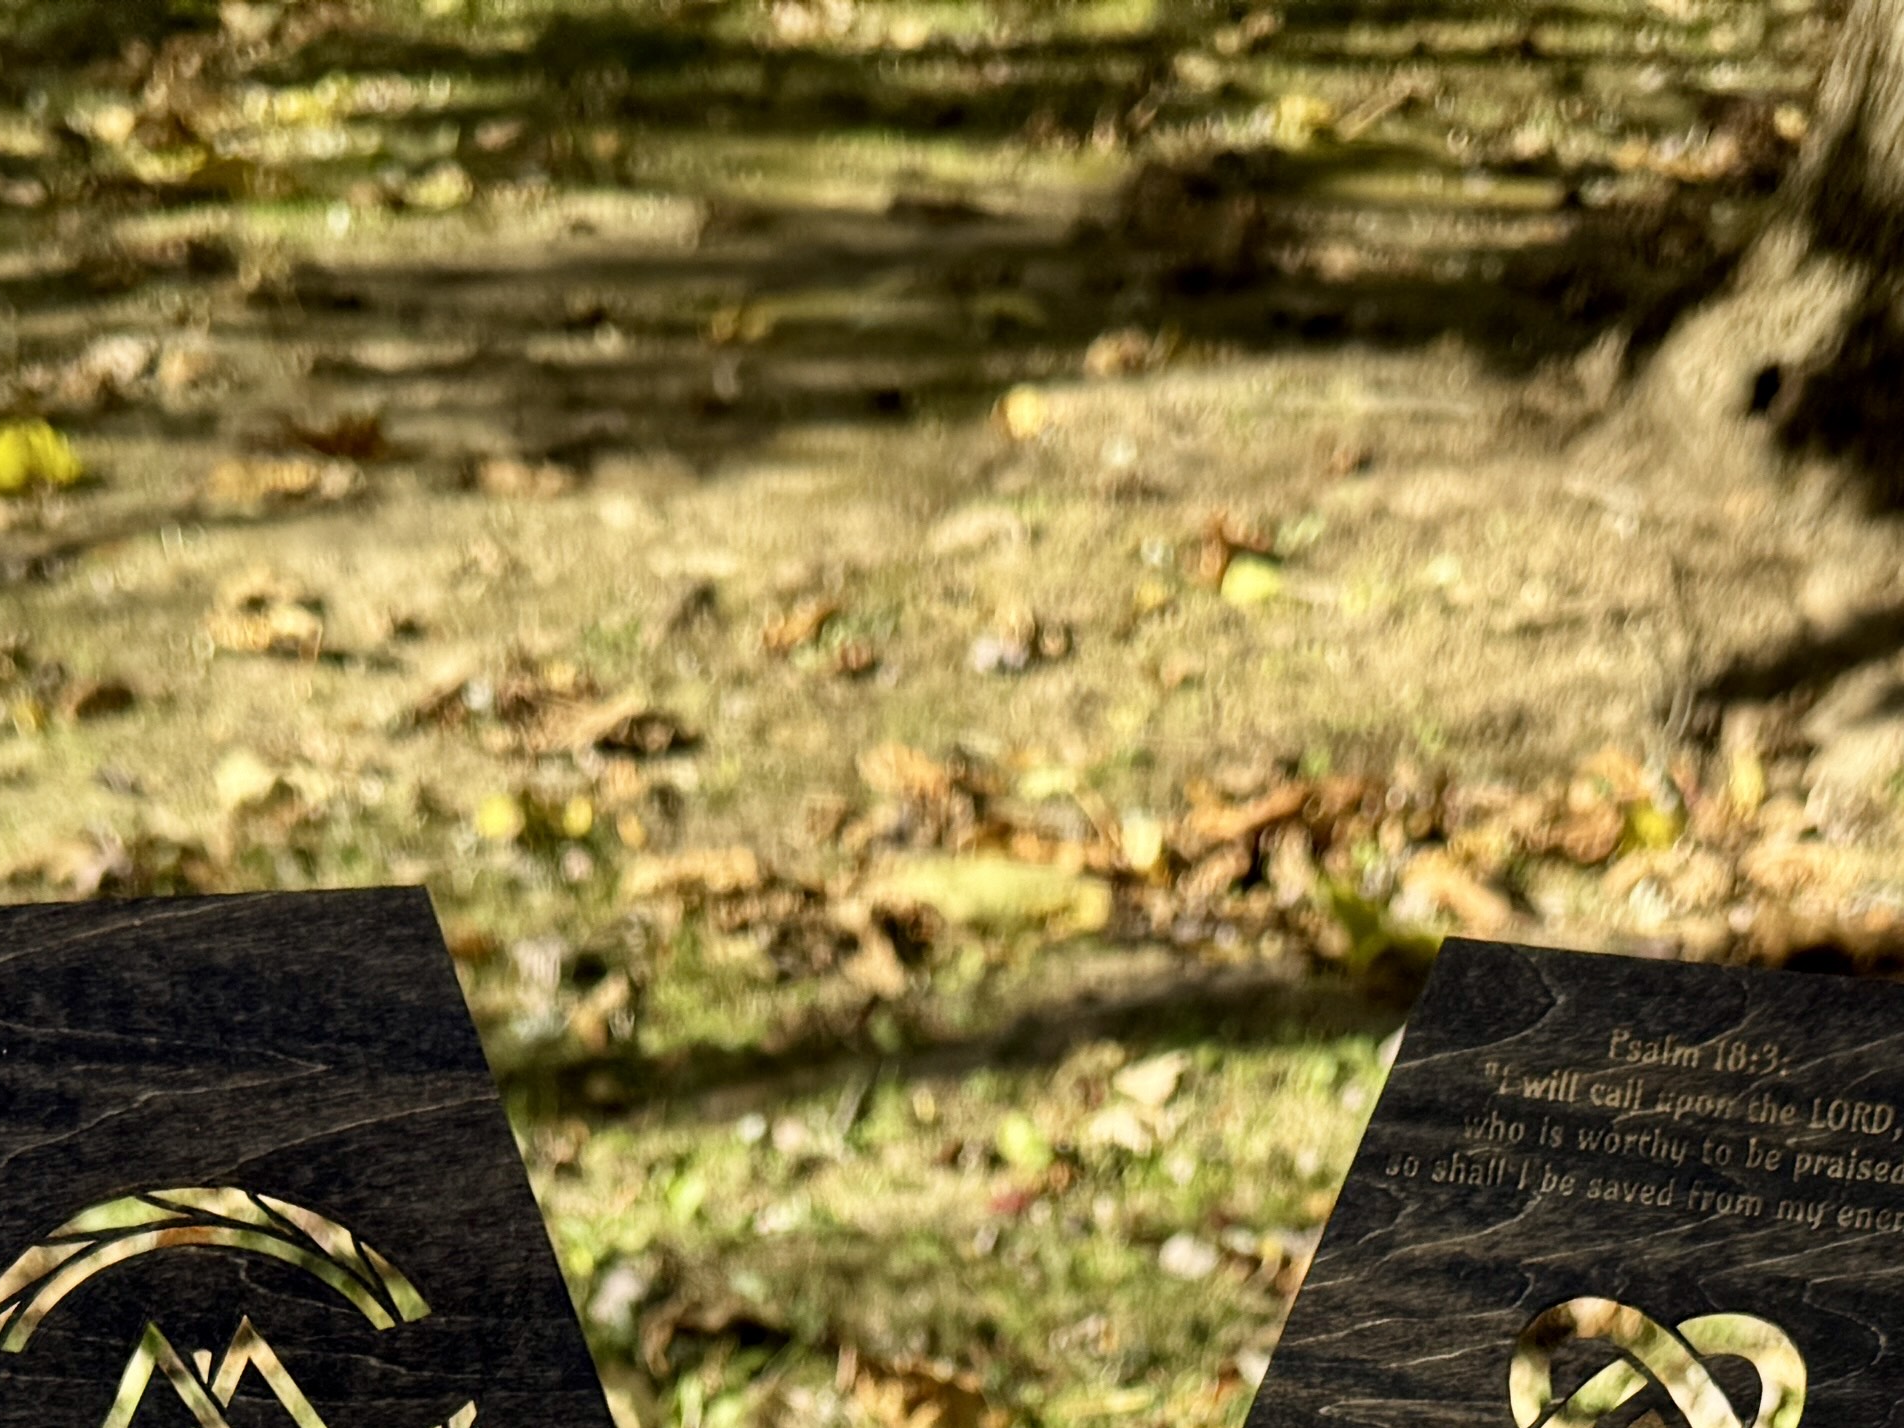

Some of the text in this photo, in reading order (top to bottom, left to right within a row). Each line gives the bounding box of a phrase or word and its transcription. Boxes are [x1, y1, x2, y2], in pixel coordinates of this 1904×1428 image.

[1608, 1027, 1698, 1068] Psalm
[1522, 1068, 1579, 1103] will
[1590, 1077, 1644, 1109] call
[1654, 1089, 1735, 1121] upon
[1747, 1092, 1796, 1125] the
[1807, 1097, 1903, 1141] LORD,
[1463, 1110, 1525, 1144] who
[1539, 1115, 1563, 1148] is
[1578, 1127, 1688, 1167] worthy
[1702, 1137, 1731, 1165] to
[1746, 1136, 1782, 1171] be
[1385, 1155, 1420, 1177] so
[1431, 1152, 1507, 1186] shall
[1517, 1157, 1529, 1190] I
[1541, 1163, 1576, 1196] be
[1586, 1178, 1676, 1206] saved
[1687, 1180, 1763, 1216] from
[1776, 1199, 1826, 1230] my
